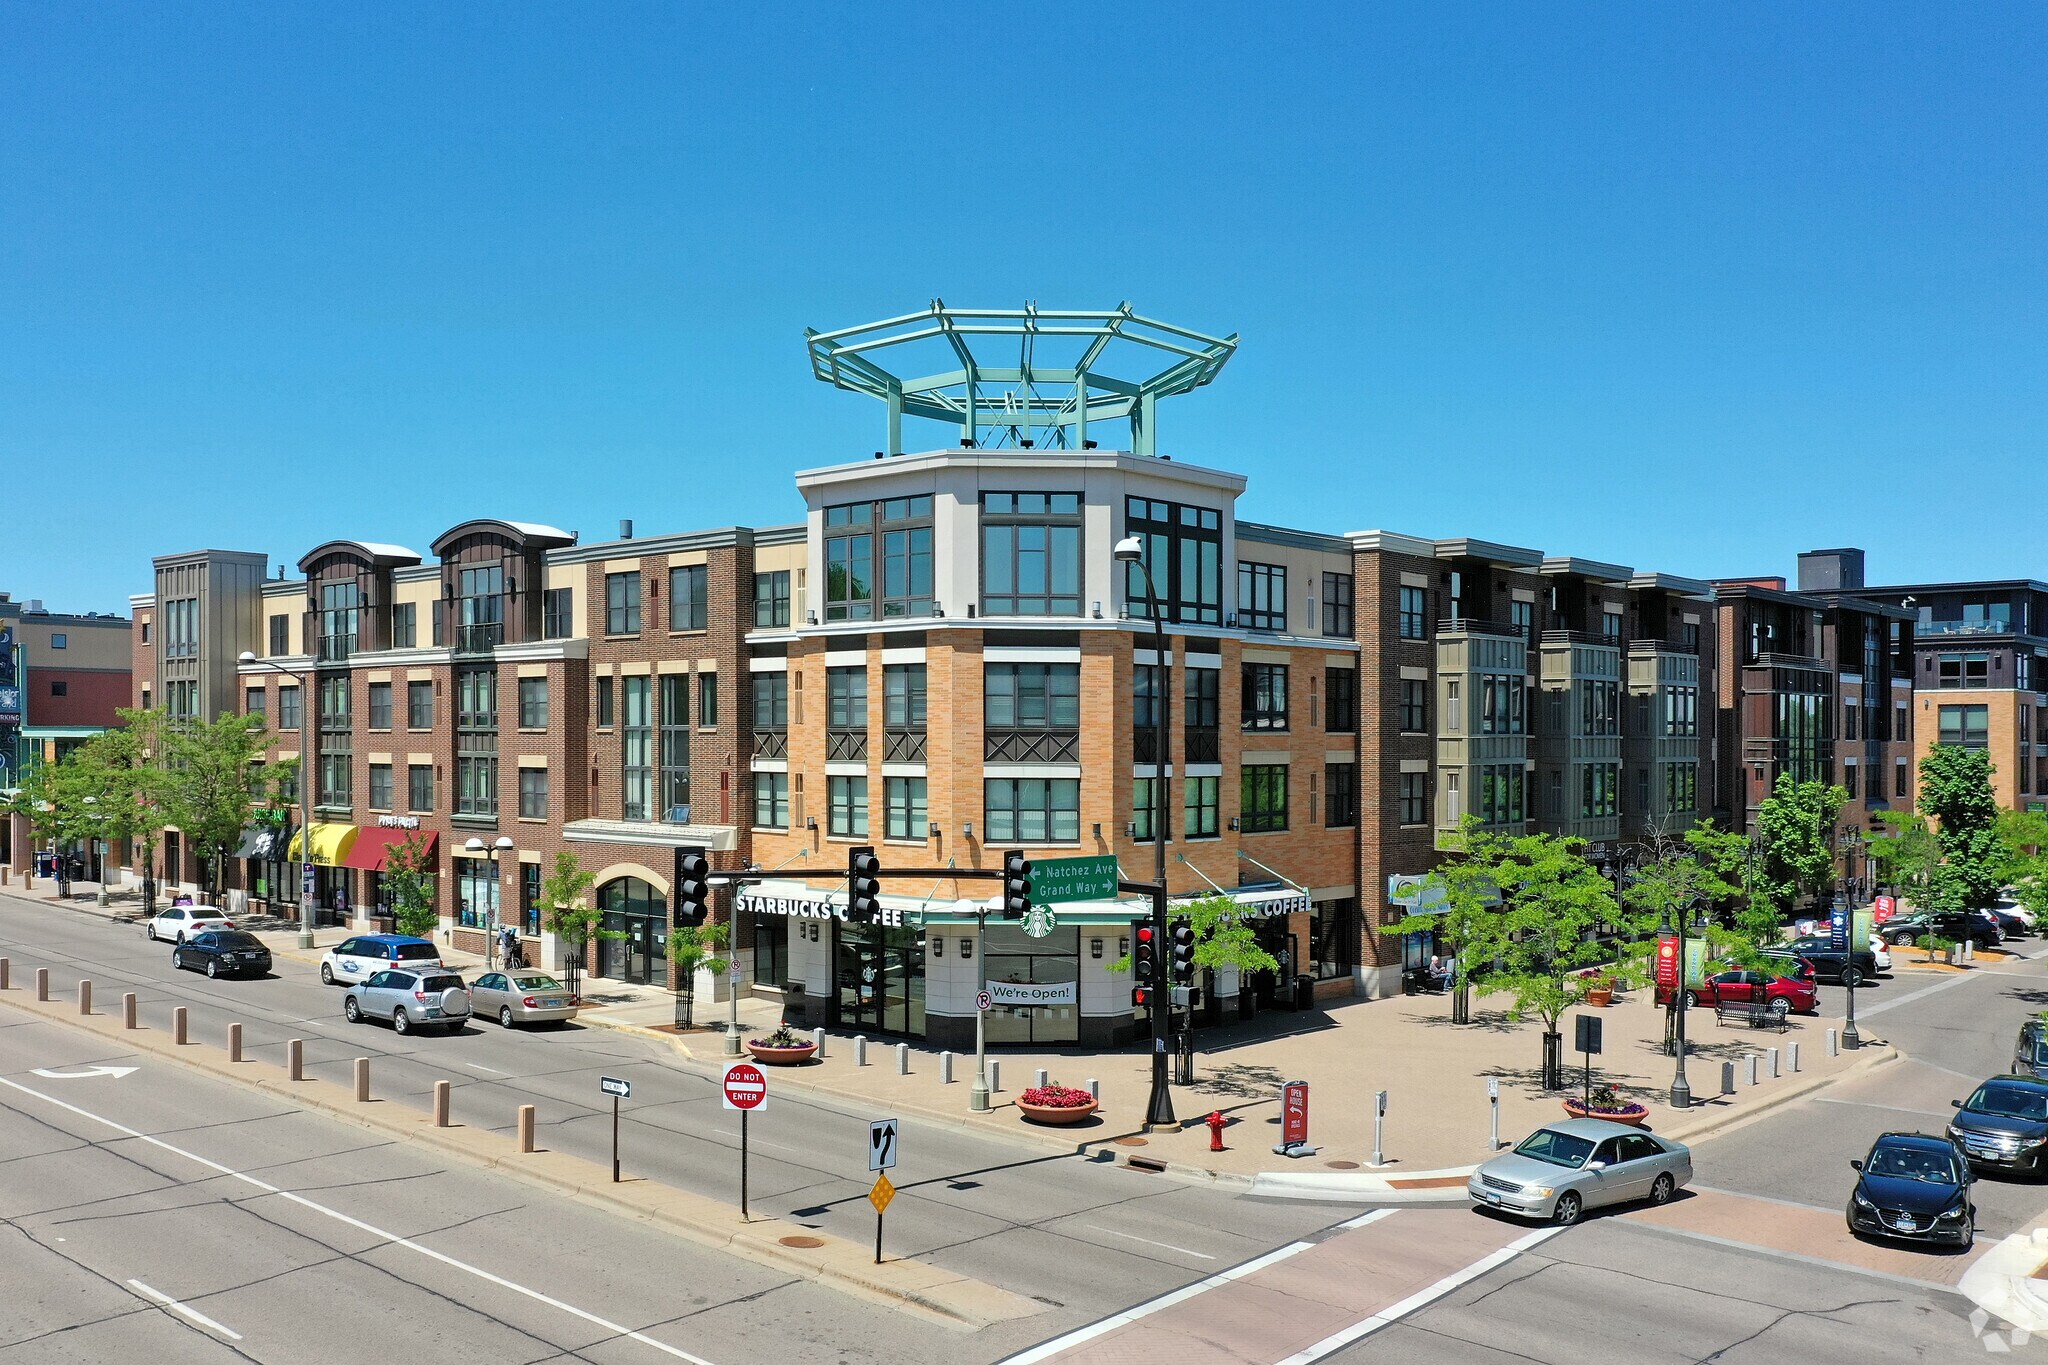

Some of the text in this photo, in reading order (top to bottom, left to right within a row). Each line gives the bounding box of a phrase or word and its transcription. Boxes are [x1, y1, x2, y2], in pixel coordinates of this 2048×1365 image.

[1592, 842, 1605, 852] CLUB
[1046, 863, 1113, 878] Natchez Ave
[1040, 882, 1097, 896] Grand Way
[736, 895, 902, 927] STARBUCKS CFEE
[1264, 896, 1312, 917] COFFEE
[993, 986, 1069, 1000] We're Open!
[730, 1072, 760, 1081] DO NOT
[732, 1092, 757, 1101] ENTER
